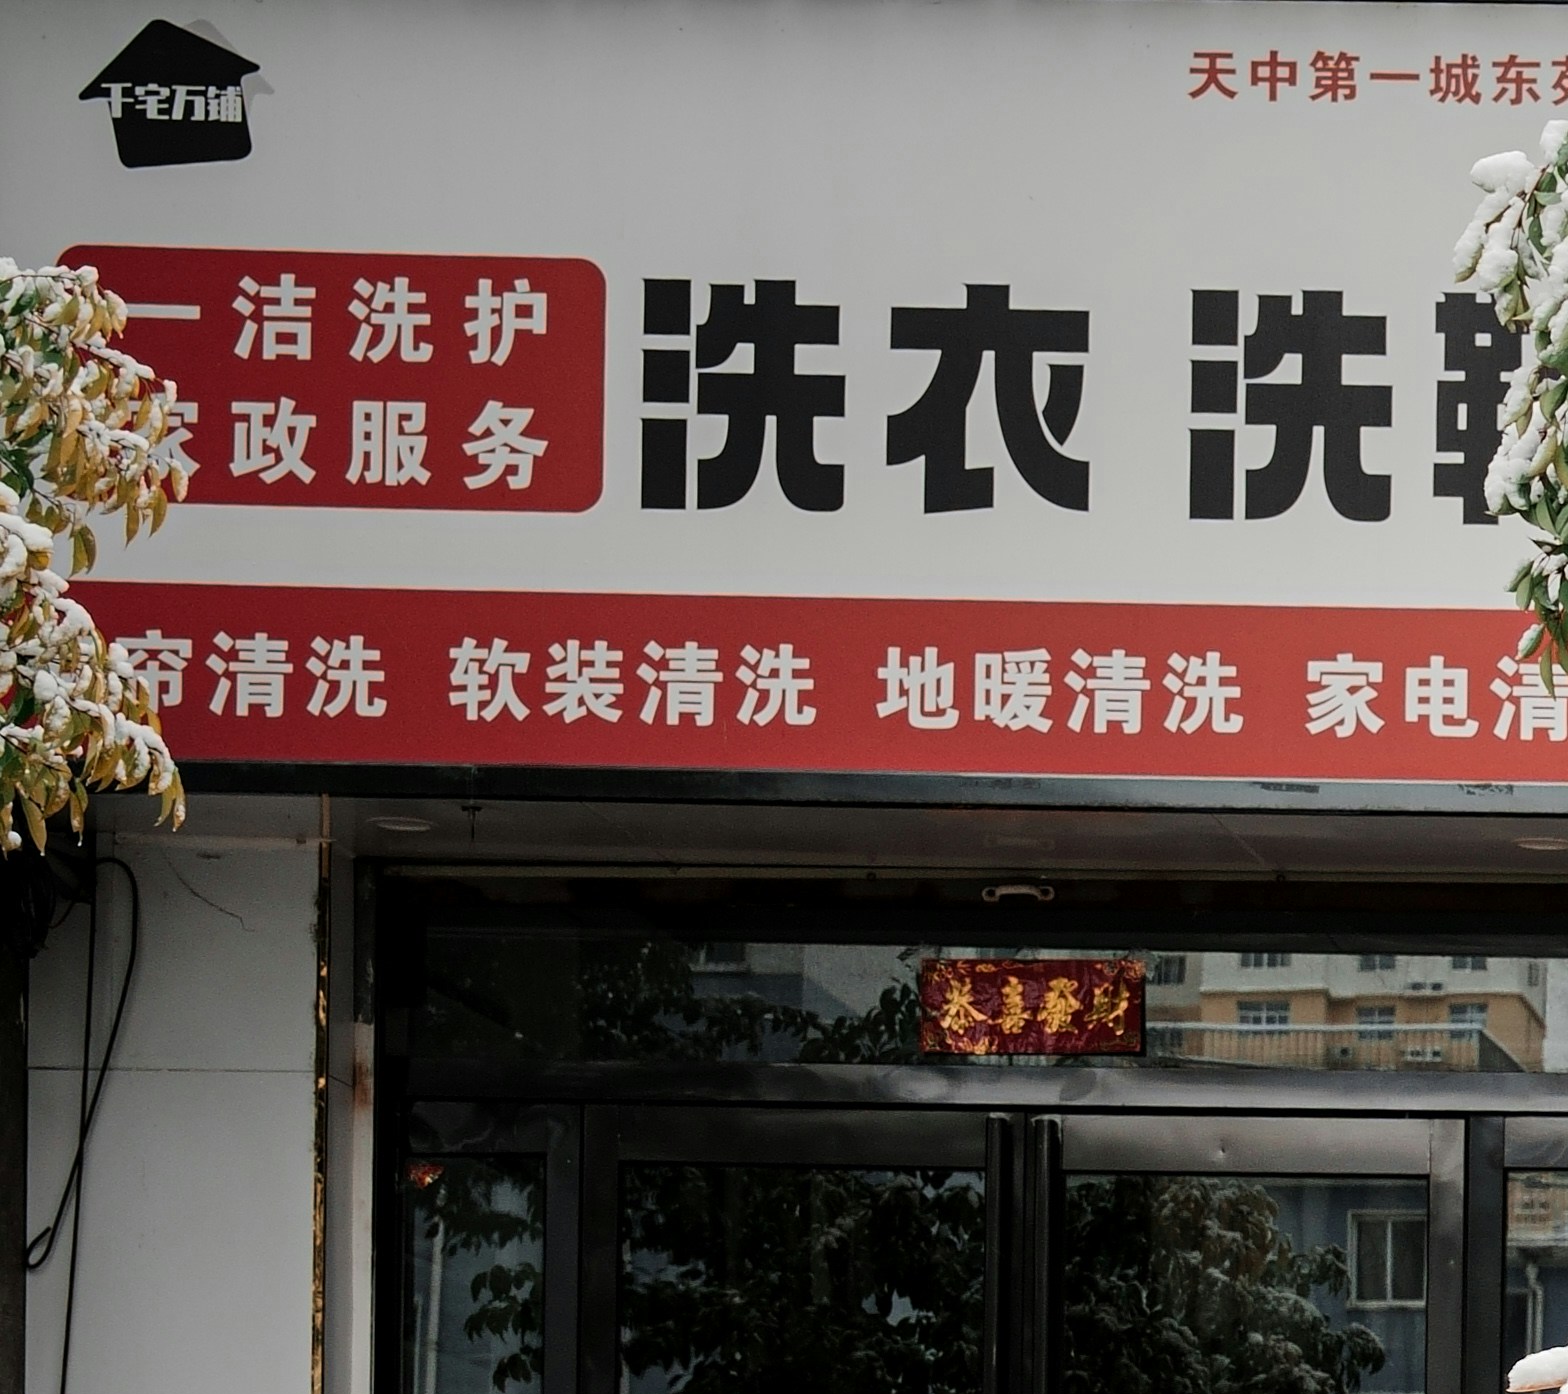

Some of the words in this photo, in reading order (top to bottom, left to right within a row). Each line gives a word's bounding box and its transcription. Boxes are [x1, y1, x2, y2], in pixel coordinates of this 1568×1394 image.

[100, 82, 243, 124] 千宅万铺
[641, 279, 1090, 514] 洗衣
[448, 637, 817, 728] 软装清洗
[877, 645, 1244, 736] 地暖清洗
